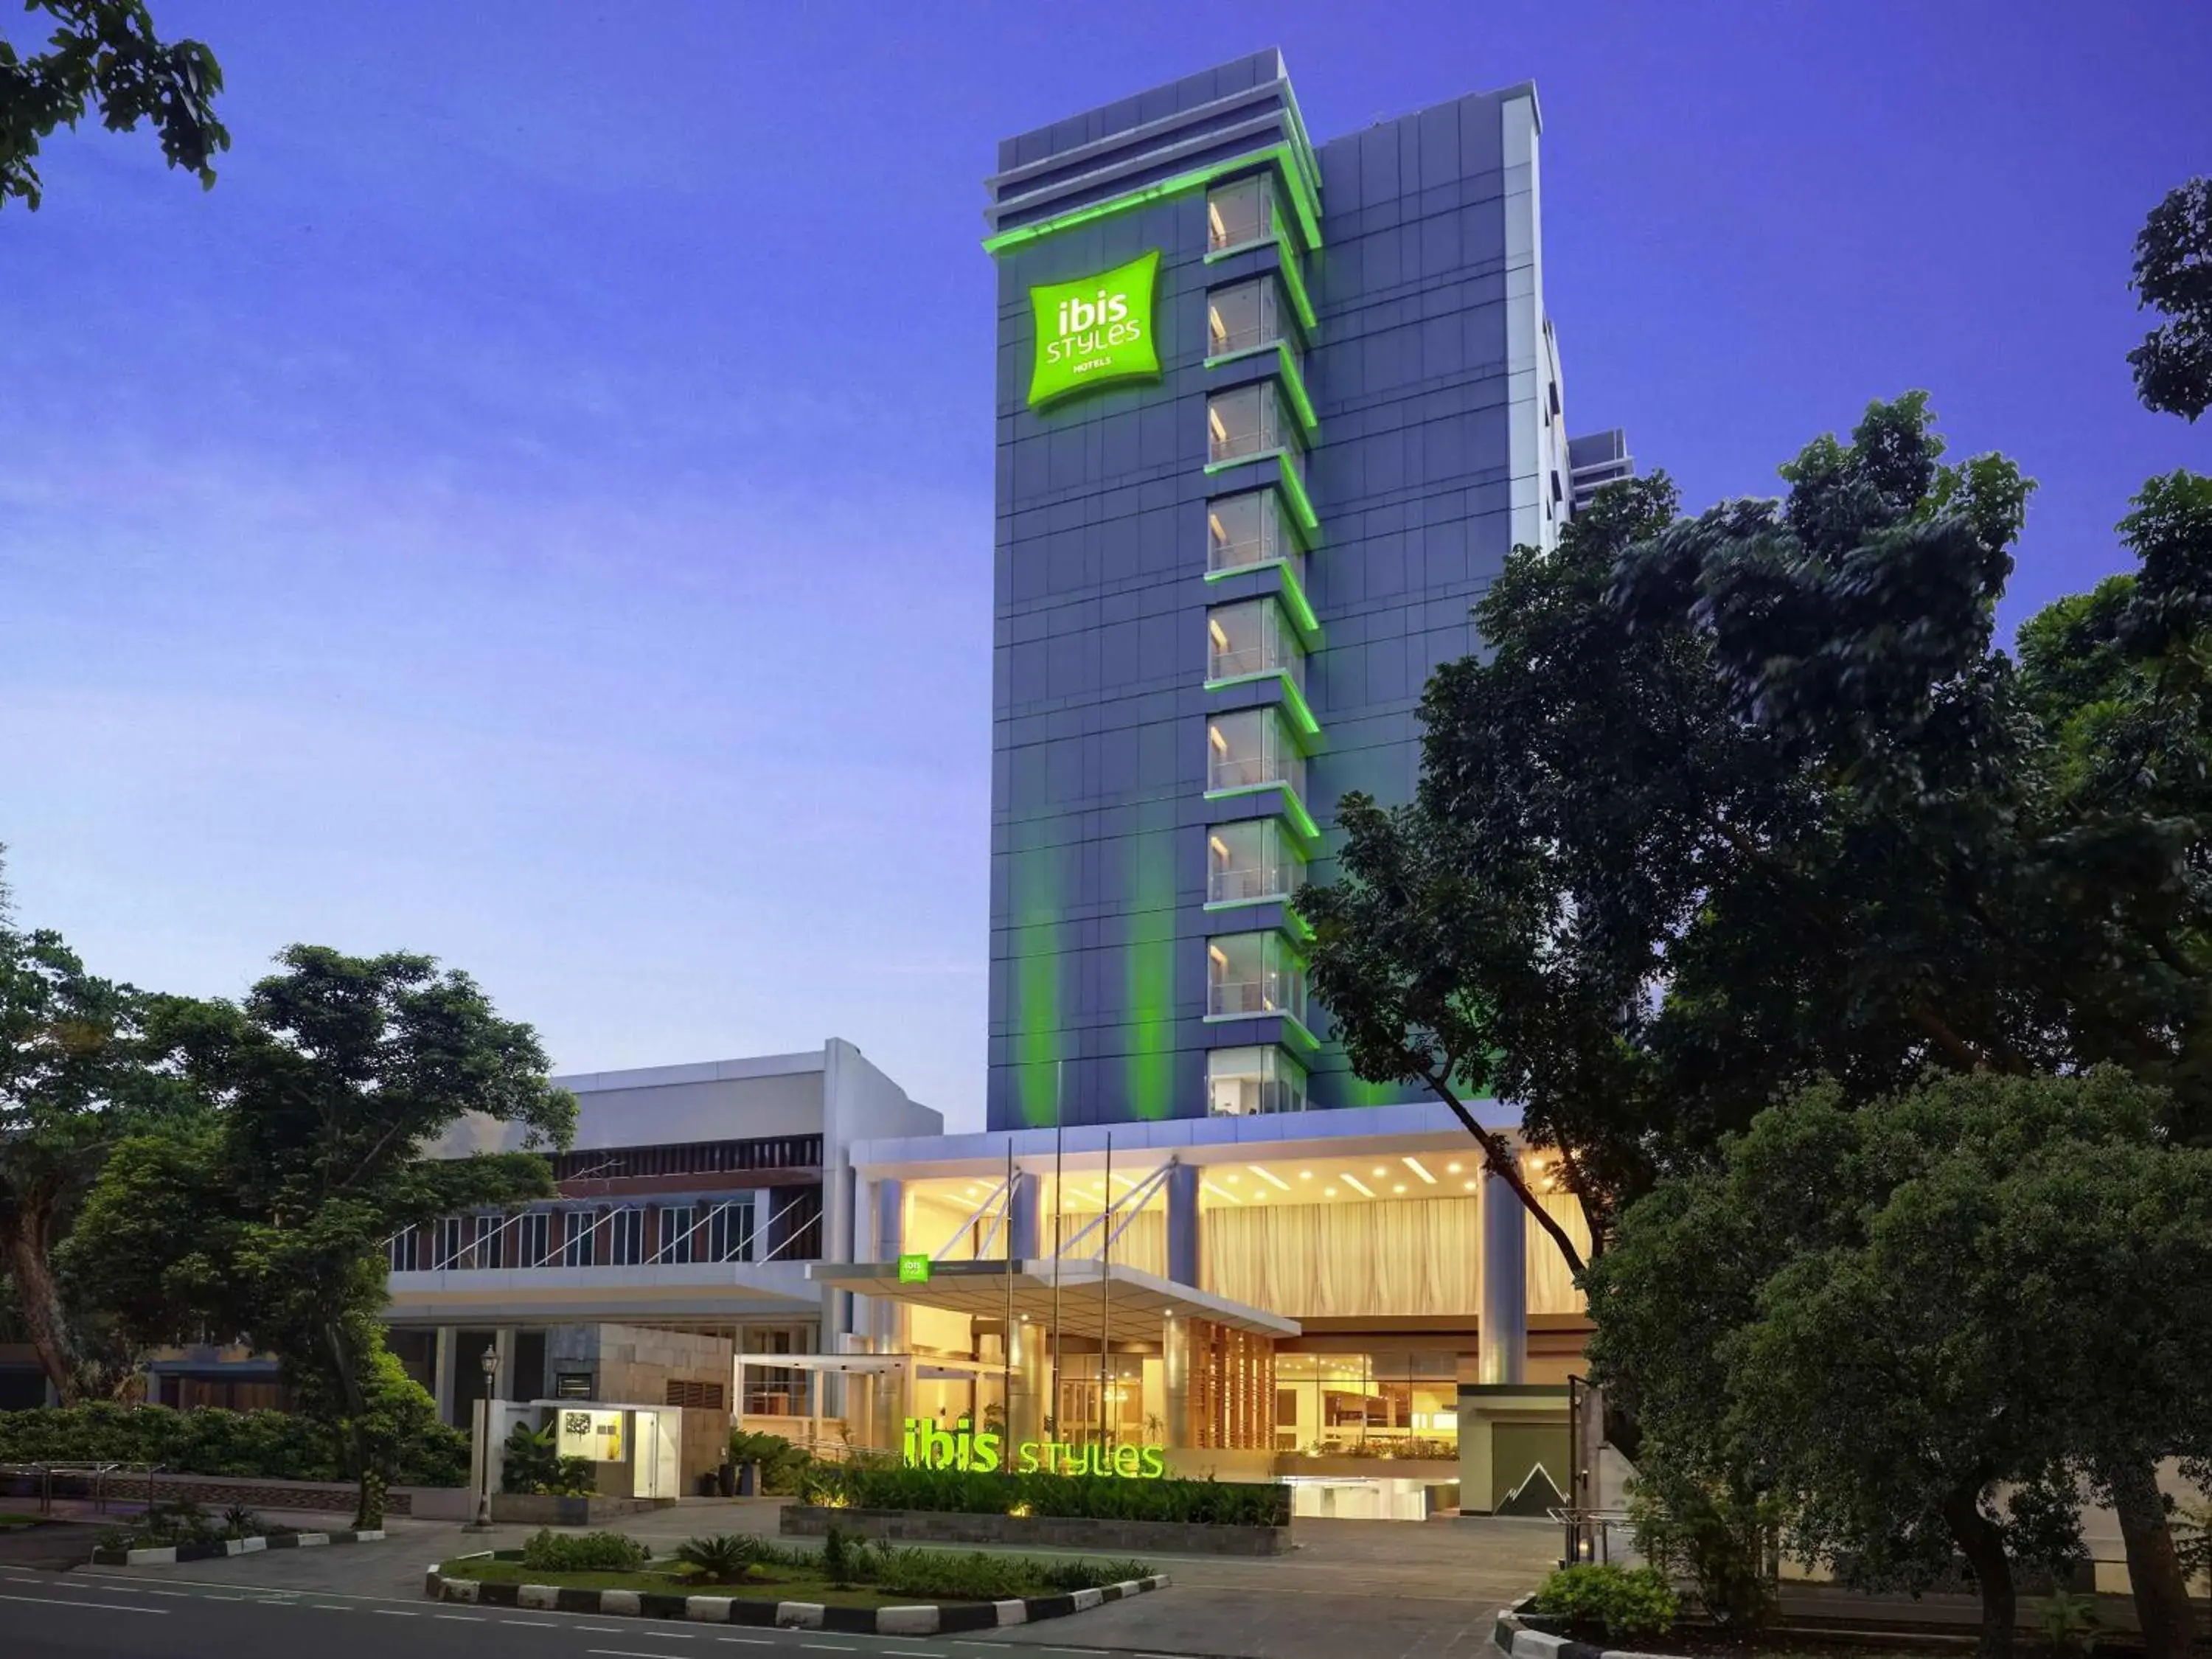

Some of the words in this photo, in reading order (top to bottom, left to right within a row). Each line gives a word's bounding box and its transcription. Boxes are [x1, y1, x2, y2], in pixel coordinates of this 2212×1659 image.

[1059, 290, 1127, 336] ibis
[1073, 357, 1112, 373] HOTELS
[904, 1417, 1000, 1473] ibis
